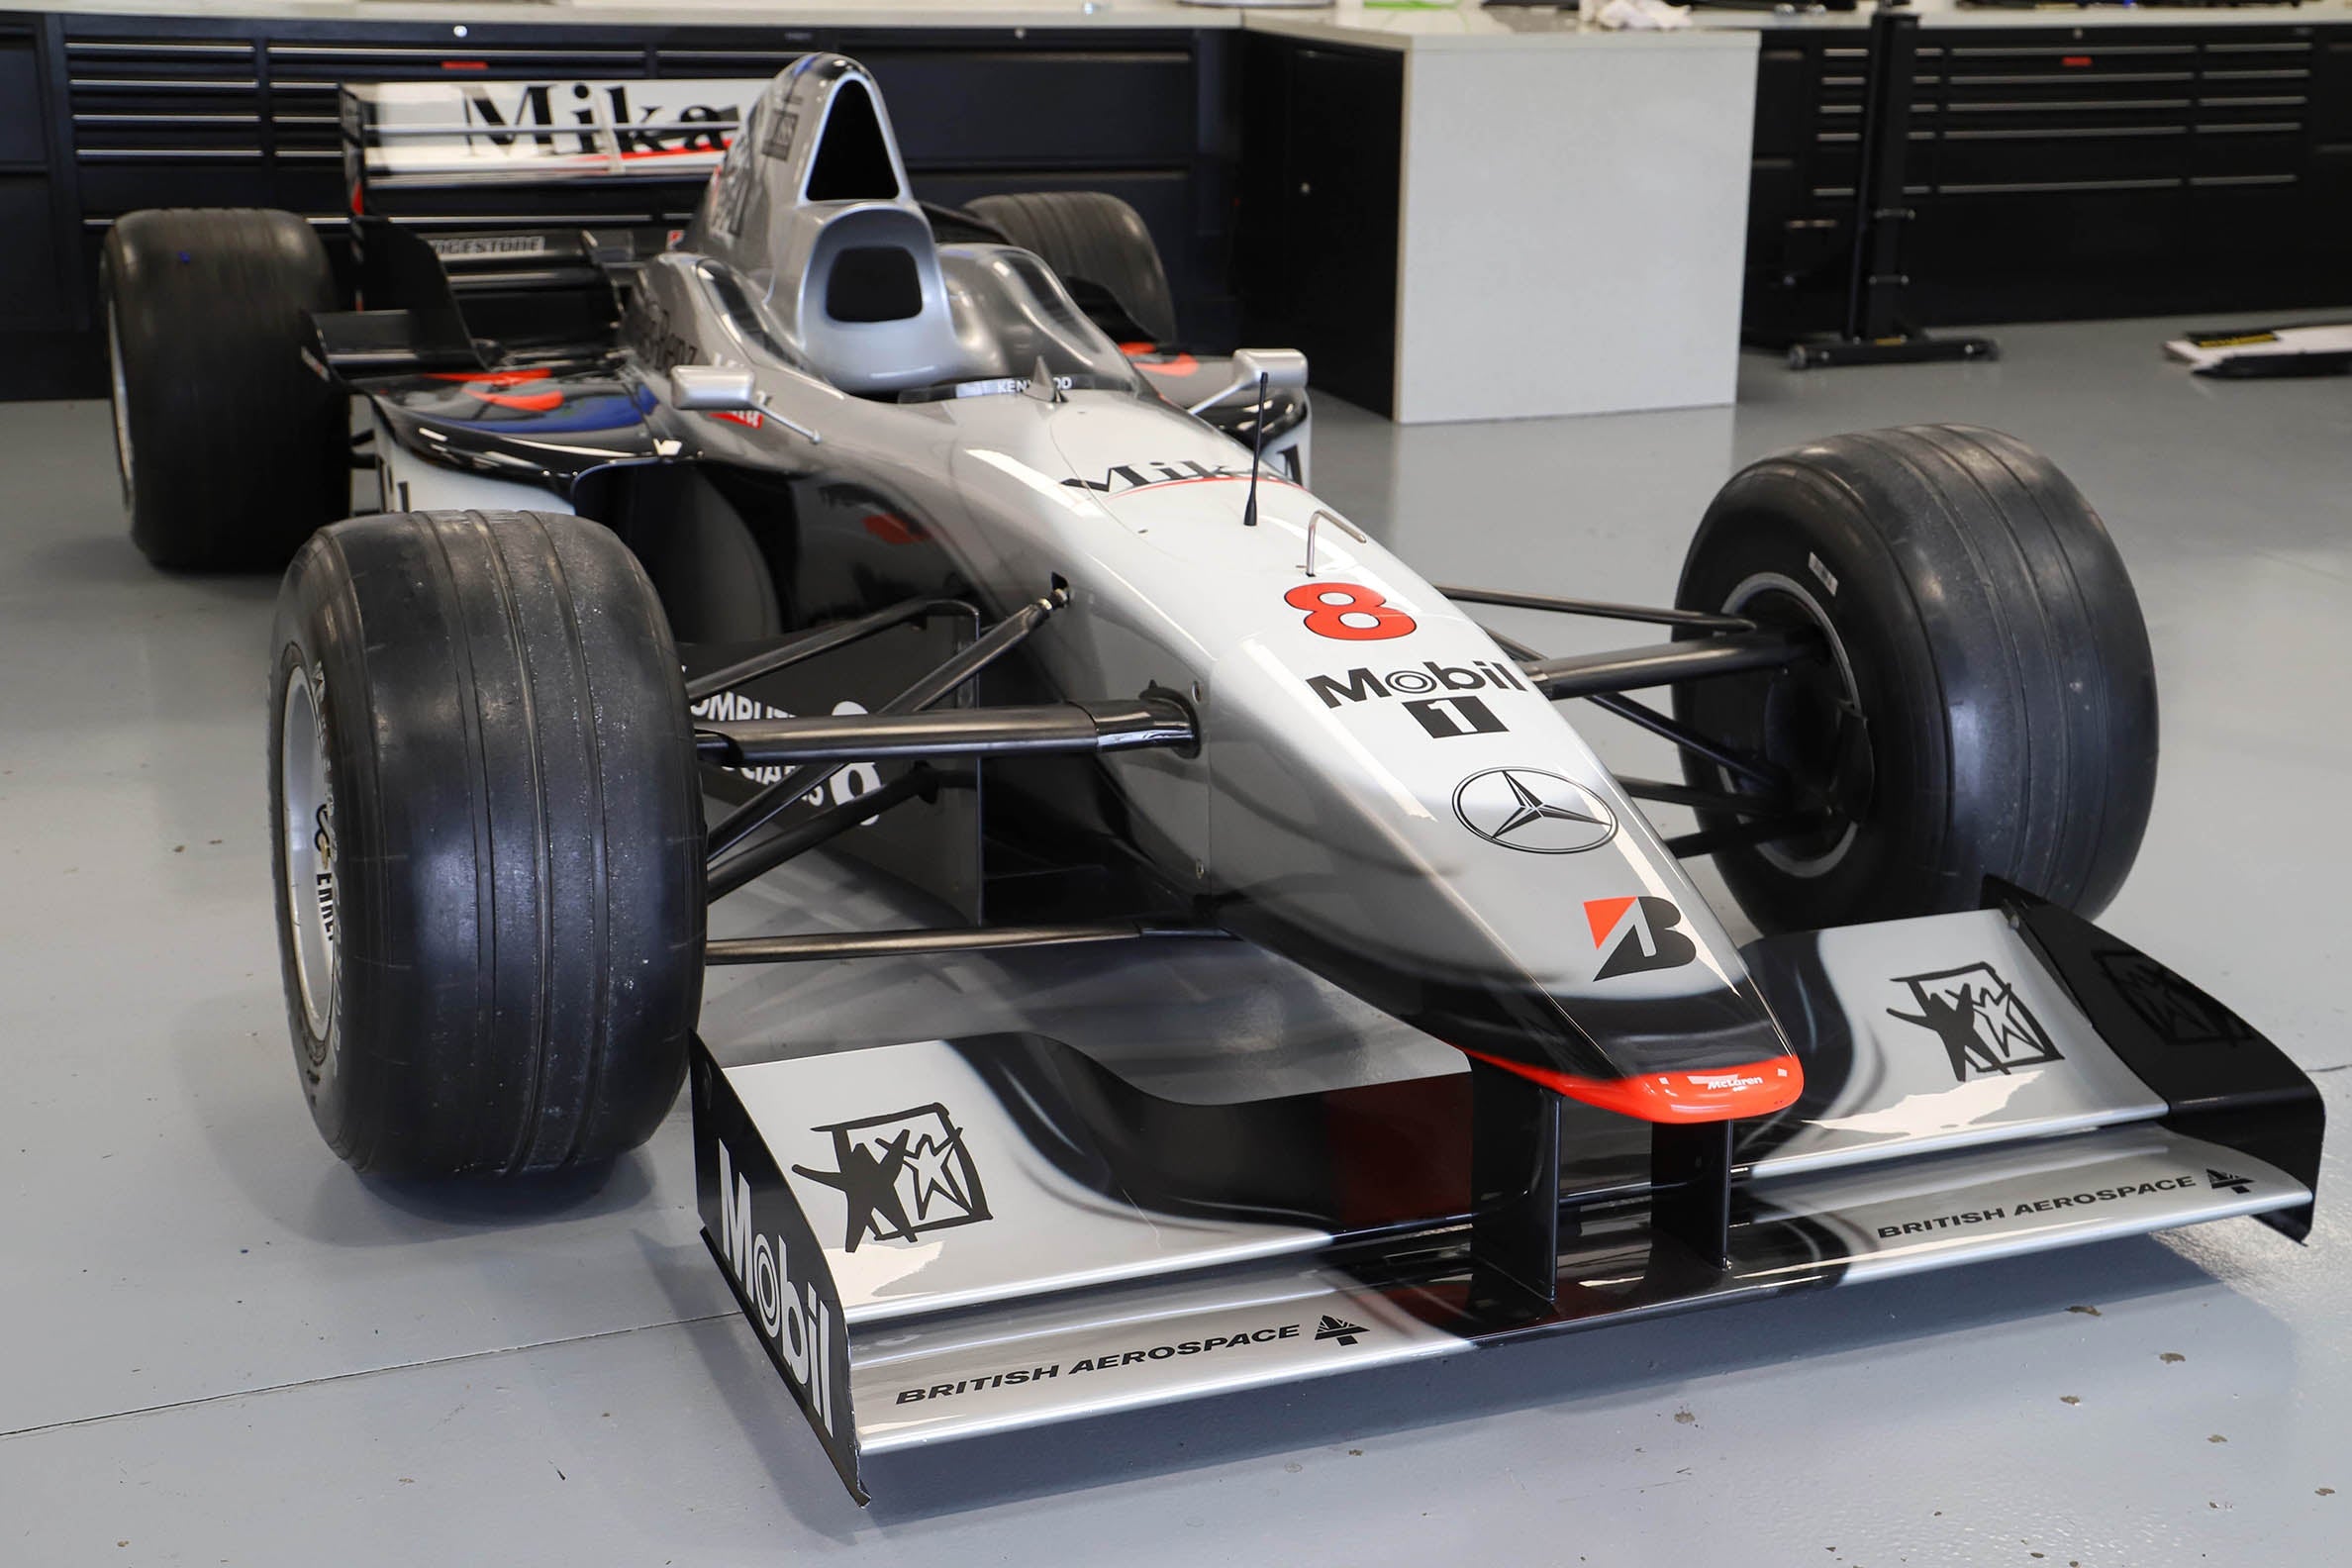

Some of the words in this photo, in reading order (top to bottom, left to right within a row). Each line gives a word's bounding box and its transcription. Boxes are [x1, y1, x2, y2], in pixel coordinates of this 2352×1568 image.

[997, 376, 1072, 394] KENOD
[1284, 582, 1418, 641] 8
[1305, 660, 1529, 710] Mobil
[1707, 1076, 1764, 1091] McLaren
[1876, 1207, 2006, 1239] BRITISH
[2013, 1175, 2197, 1218] AEROSPACE
[718, 1137, 834, 1439] Mobil
[895, 1364, 1060, 1406] BRITISH
[1067, 1323, 1302, 1375] AEROSPACE
